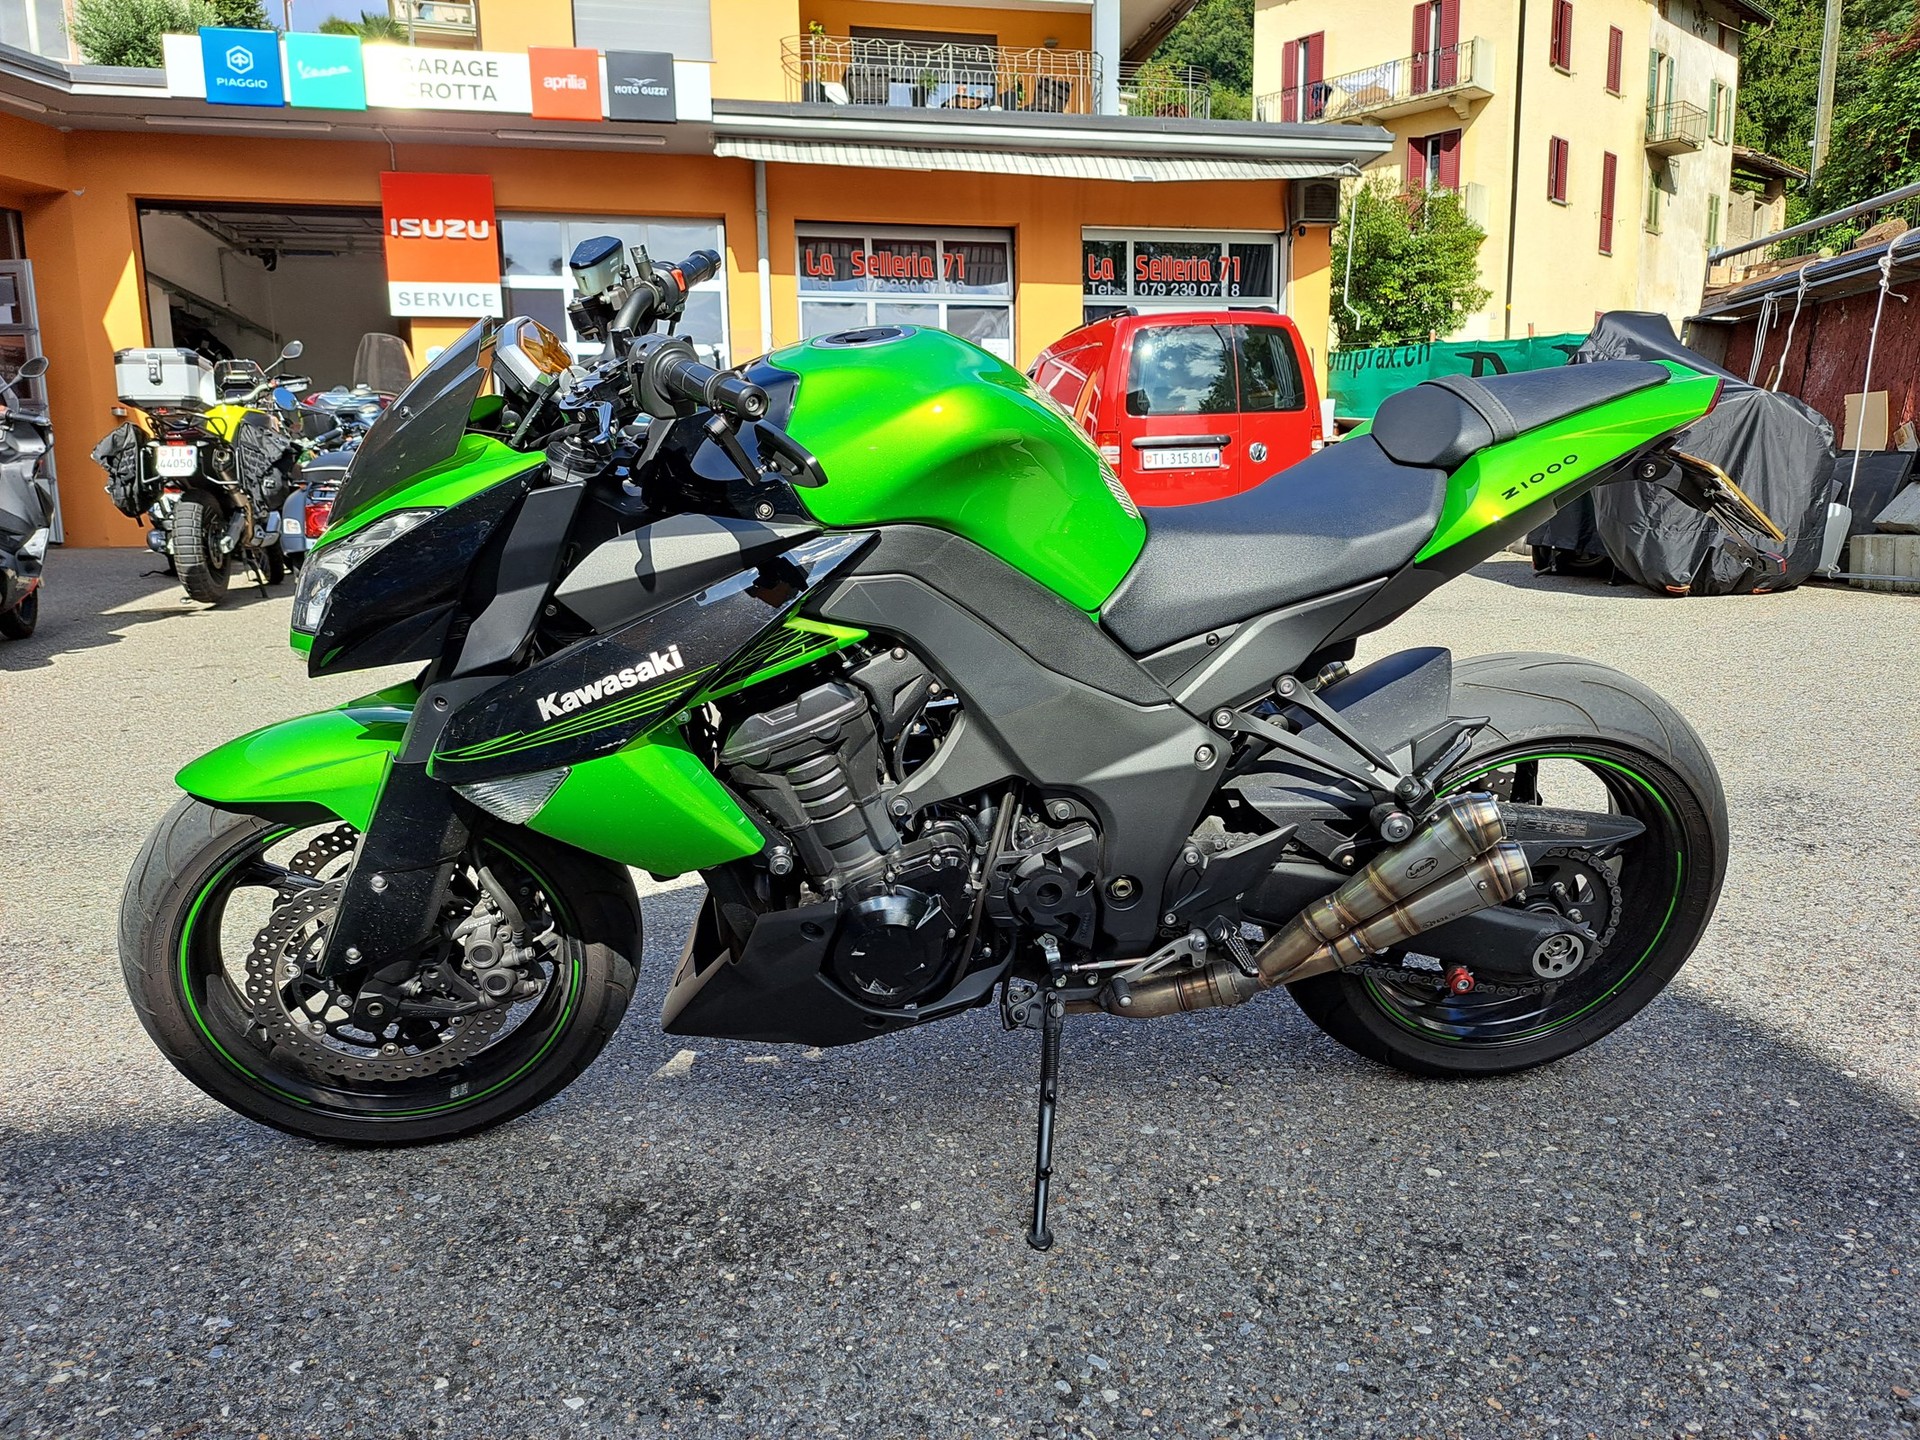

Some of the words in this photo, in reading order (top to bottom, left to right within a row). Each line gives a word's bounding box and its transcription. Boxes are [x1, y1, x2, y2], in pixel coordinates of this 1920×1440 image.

[216, 77, 268, 89] PIAGGIO
[406, 82, 498, 102] ROTTA
[543, 73, 588, 92] aprilia
[614, 85, 640, 95] MOTO
[640, 86, 669, 96] GUZZI
[390, 218, 490, 240] ISUZU
[805, 250, 835, 276] La
[851, 250, 934, 278] Selleria
[941, 253, 965, 279] 71
[1088, 254, 1115, 281] La
[1135, 254, 1212, 282] Selleria
[1219, 256, 1241, 282] 71
[1139, 282, 1167, 296] 079
[1170, 283, 1198, 296] 230
[398, 291, 495, 308] SERVICE
[1501, 454, 1578, 501] Z1000
[536, 644, 685, 722] Kawasaki
